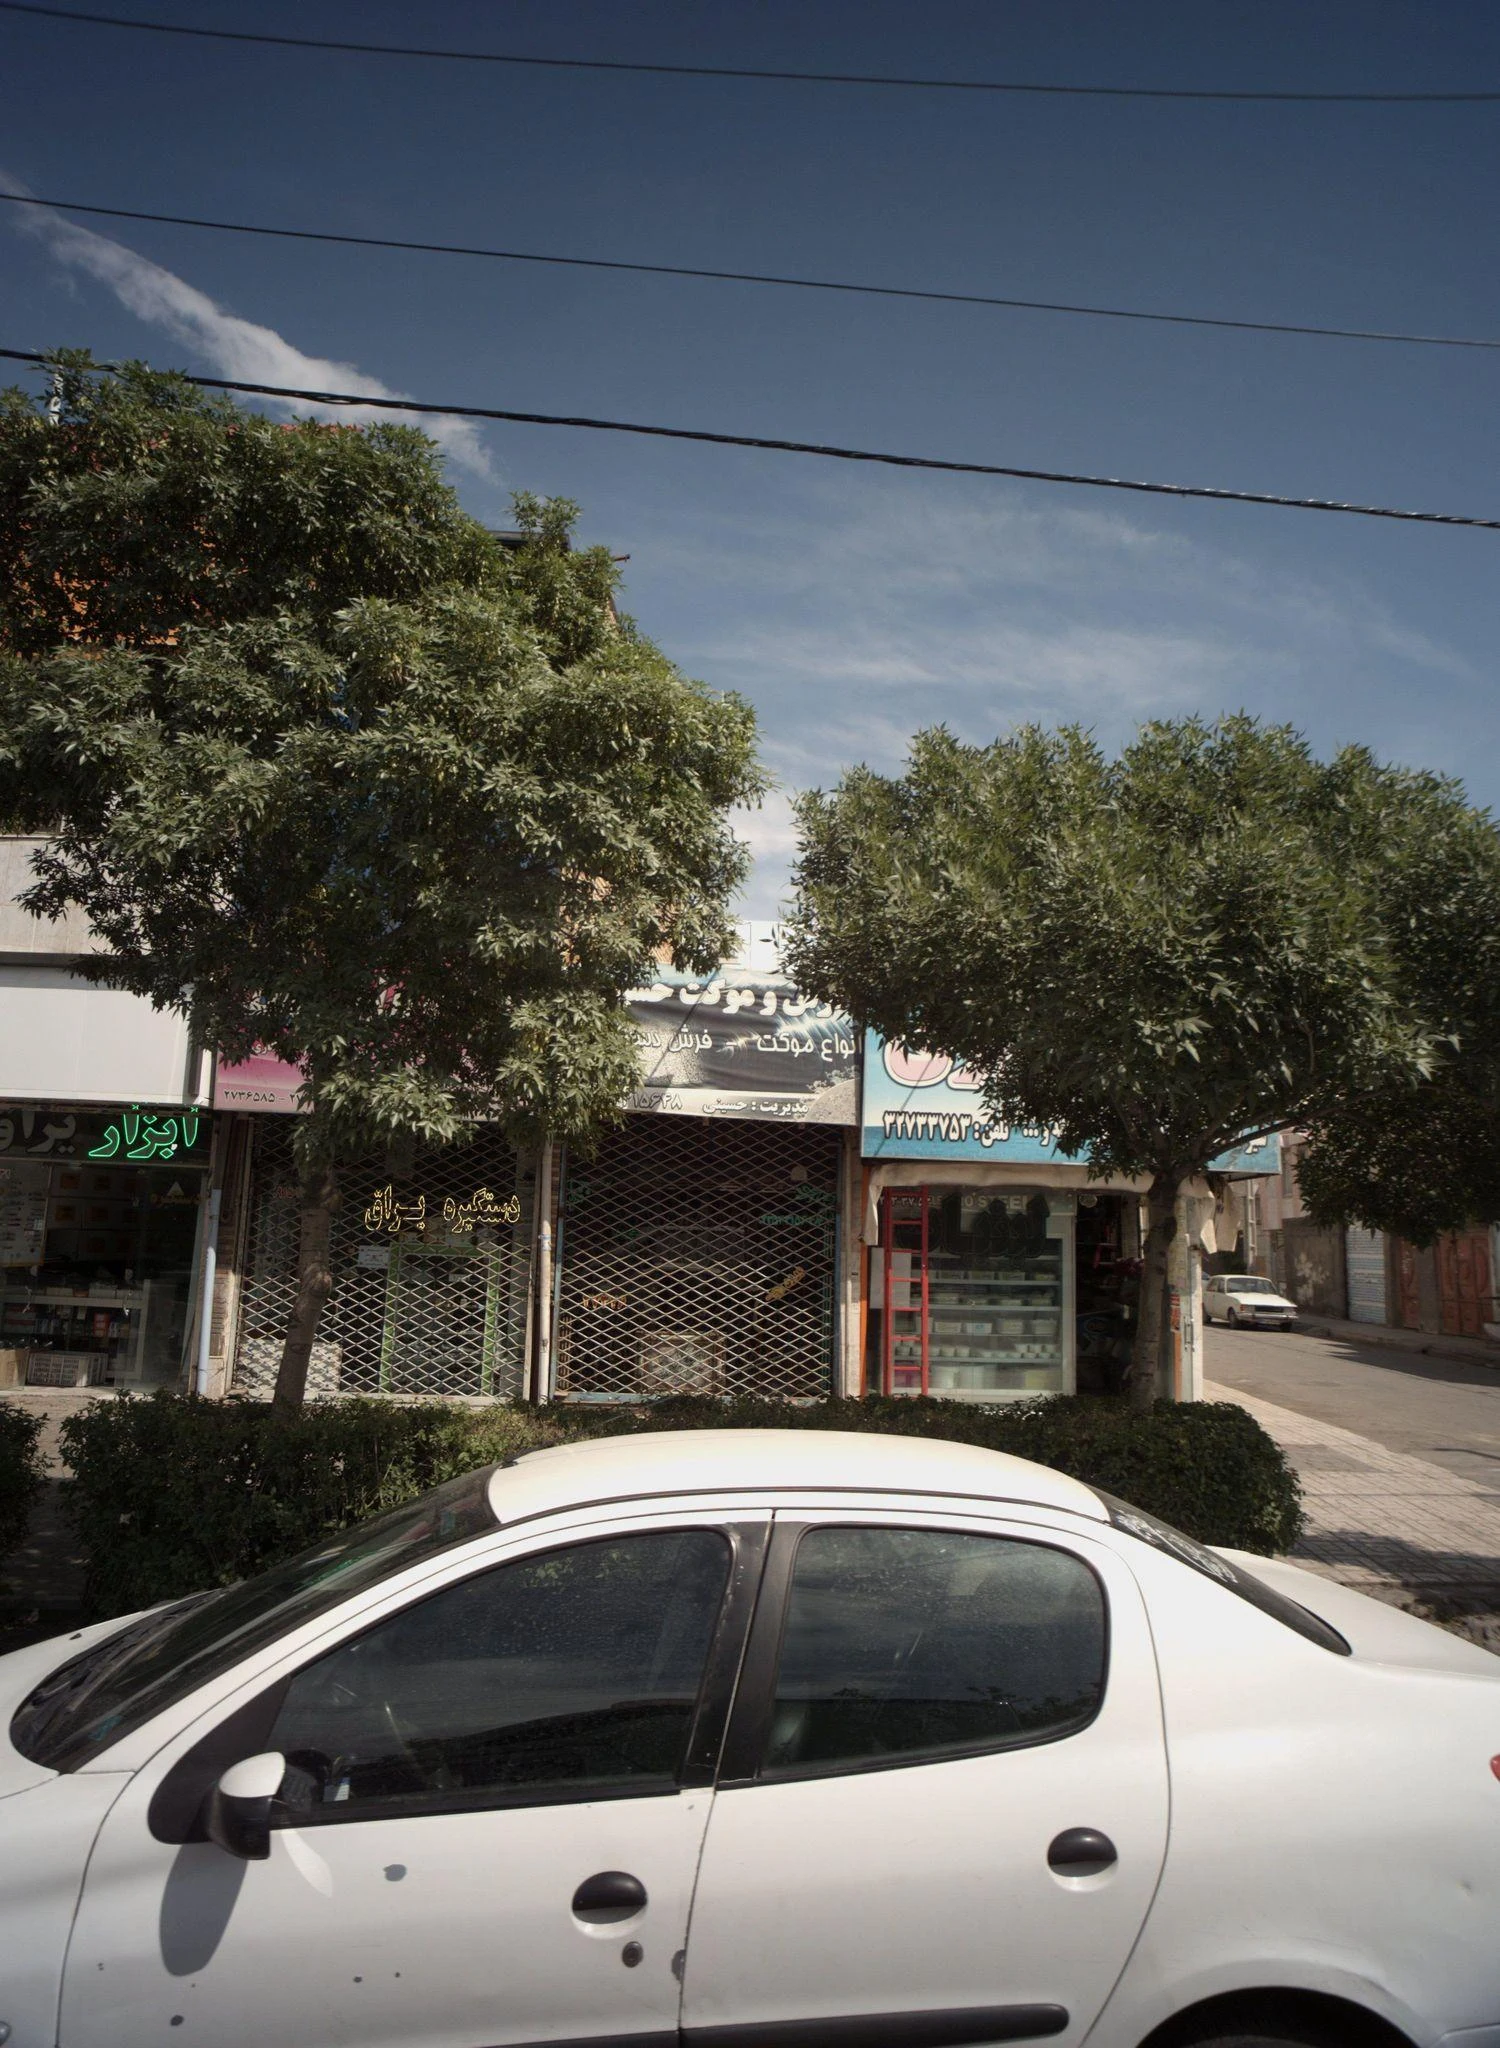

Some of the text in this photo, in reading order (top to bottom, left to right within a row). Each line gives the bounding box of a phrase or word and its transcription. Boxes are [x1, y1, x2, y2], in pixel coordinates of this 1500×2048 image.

[679, 978, 755, 1014] موکت
[759, 990, 777, 1016] و
[669, 1024, 713, 1054] فرش
[756, 1032, 814, 1058] موکت
[702, 1098, 747, 1114] حسینی
[759, 1101, 809, 1117] مدیریت
